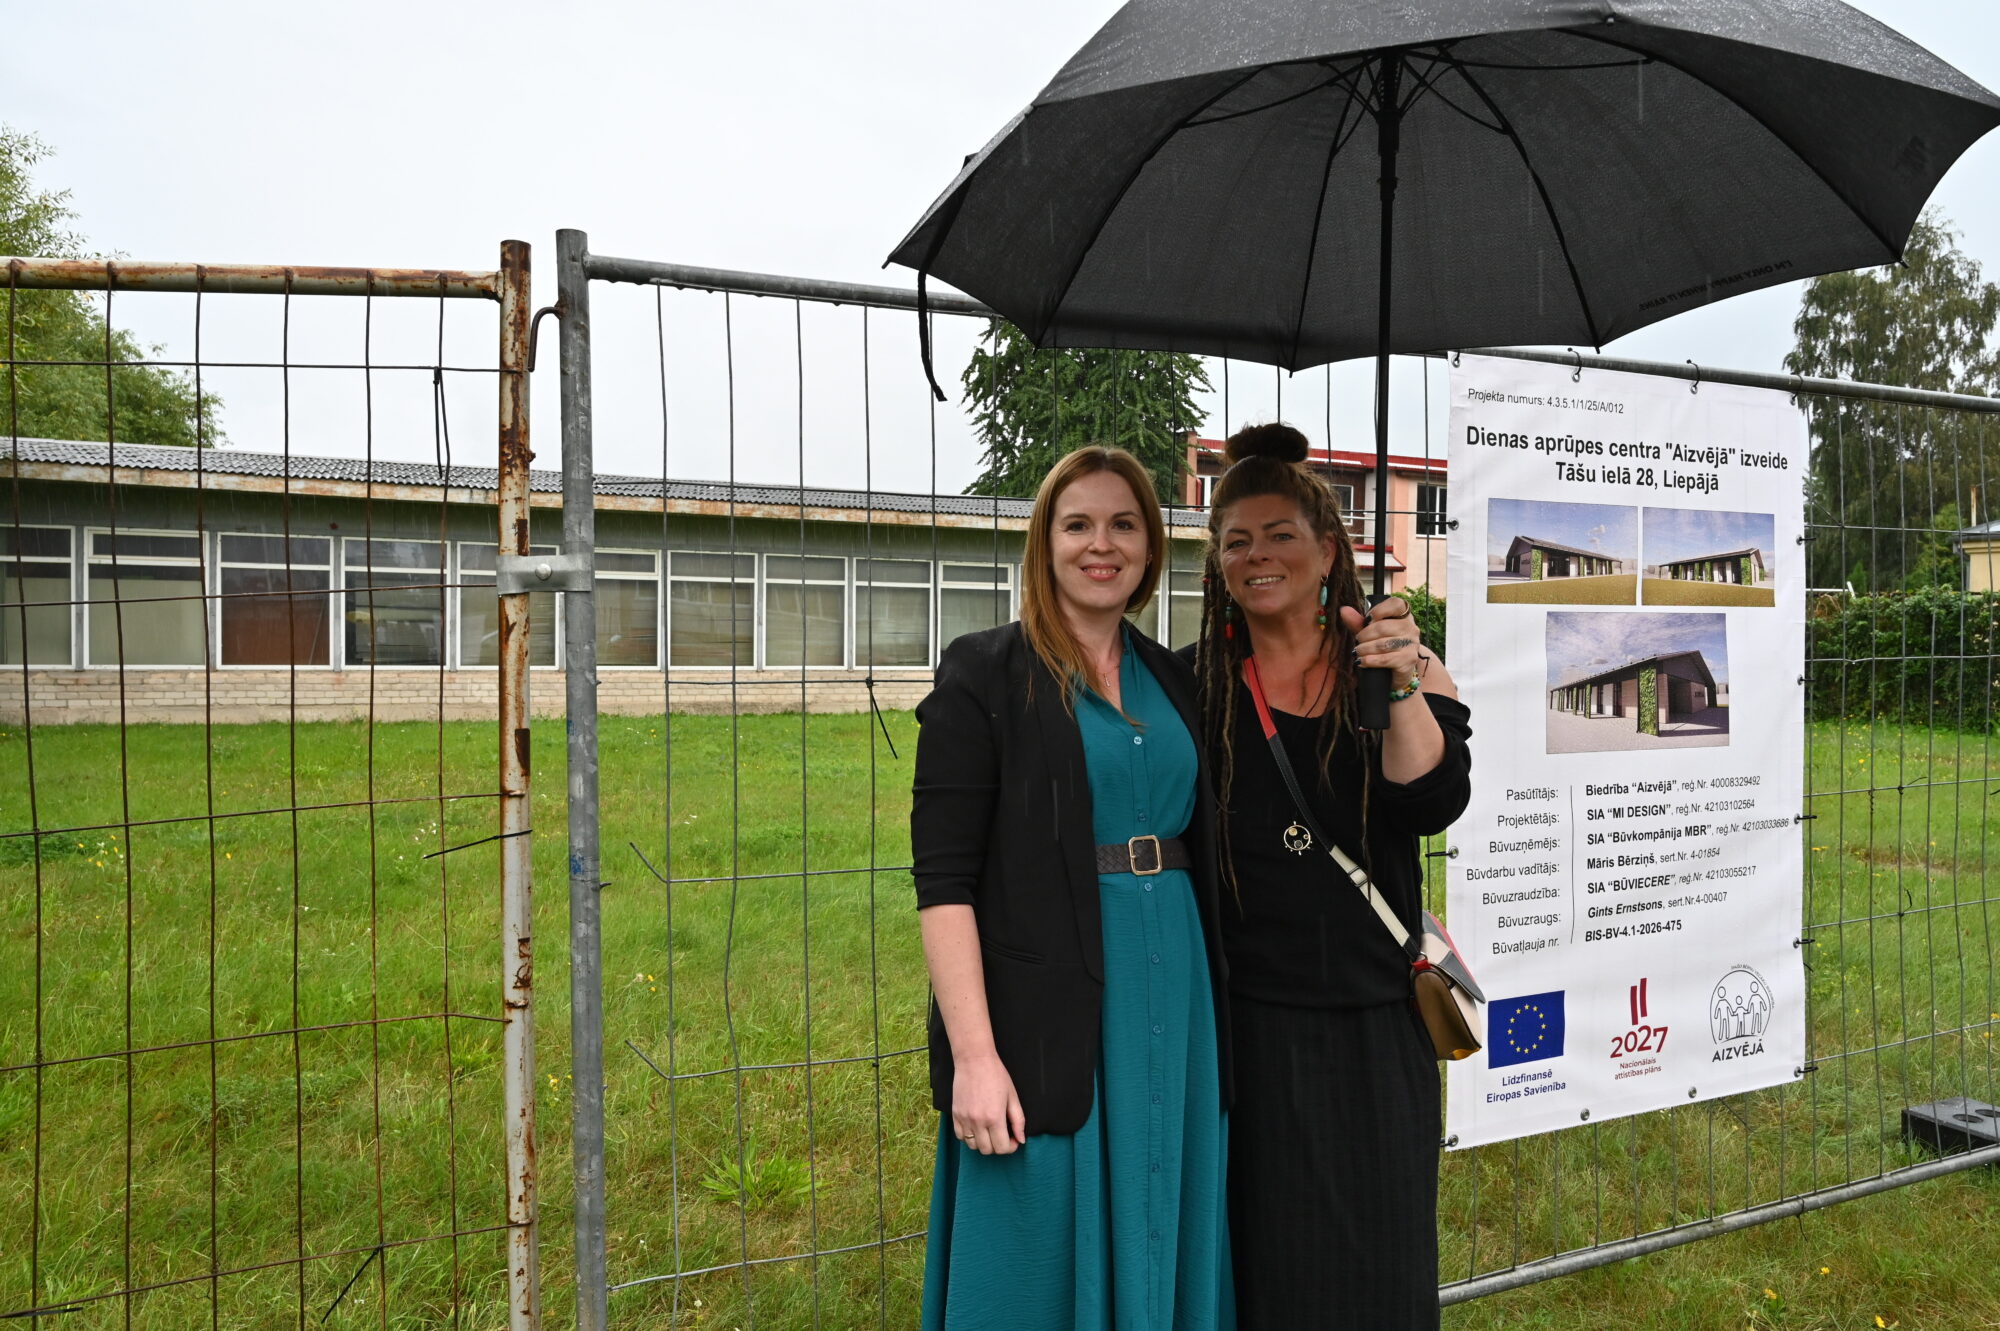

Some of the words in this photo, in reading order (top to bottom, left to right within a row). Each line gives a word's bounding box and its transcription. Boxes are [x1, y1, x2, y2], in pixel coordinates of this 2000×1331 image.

[1468, 388, 1504, 403] Projekta
[1508, 394, 1545, 406] numurs:
[1547, 396, 1624, 414] 4.3.5.1/1/25/A/012
[1466, 426, 1528, 450] Dienas
[1535, 434, 1603, 458] aprūpes
[1609, 441, 1660, 460] centra
[1666, 442, 1736, 468] "Aizvējā"
[1740, 449, 1788, 470] izveide
[1556, 462, 1596, 482] Tāšu
[1602, 465, 1631, 485] ielā
[1636, 467, 1658, 490] 28,
[1664, 470, 1718, 494] Liepājā
[1506, 787, 1558, 801] Pasūtītājs:
[1586, 783, 1629, 796] Biedrība
[1587, 808, 1605, 820] SIA
[1704, 799, 1755, 812] 42103102564
[1497, 812, 1560, 828] Projektētājs:
[1489, 837, 1560, 853] Būvuzņēmējs:
[1587, 833, 1605, 845] SIA
[1608, 827, 1682, 843] “Būvkompānija
[1587, 857, 1614, 870] Māris
[1618, 852, 1658, 868] Bērziņš,
[1660, 852, 1688, 864] sert.Nr.
[1690, 847, 1720, 858] 4-01854
[1466, 866, 1516, 880] Būvdarbu
[1518, 862, 1560, 876] vadītājs:
[1587, 882, 1606, 894] SIA
[1706, 866, 1756, 880] 42103055217
[1482, 887, 1560, 904] Būvuzraudzība:
[1588, 906, 1613, 918] Gints
[1616, 900, 1665, 915] Ernstsons,
[1498, 912, 1561, 928] Būvuzraugs:
[1585, 920, 1682, 942] BIS-BV-4.1-2026-475
[1548, 937, 1560, 948] nr.
[1610, 1025, 1668, 1058] 2027
[1712, 1038, 1764, 1062] AIZVĒJĀ
[1502, 1068, 1552, 1086] Līdzfinansē
[1486, 1090, 1522, 1103] Eiropas
[1524, 1081, 1566, 1098] Savienība
